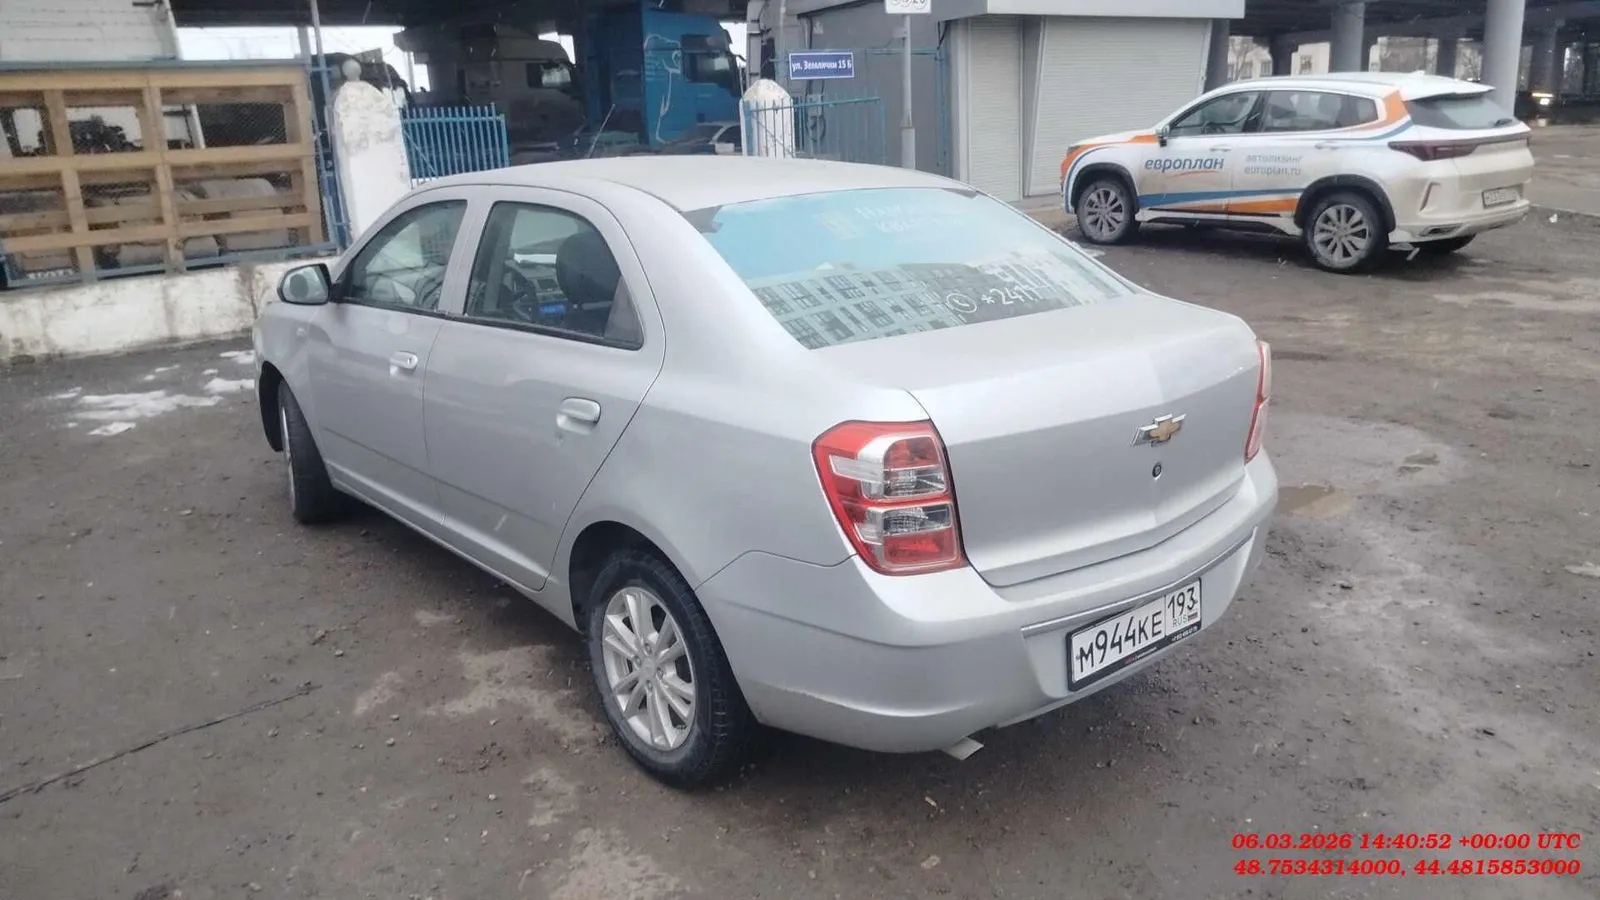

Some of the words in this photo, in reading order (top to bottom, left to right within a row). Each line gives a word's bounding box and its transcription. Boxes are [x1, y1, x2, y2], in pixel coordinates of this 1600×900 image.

[792, 62, 802, 72] ул.
[838, 60, 846, 69] 15
[1144, 156, 1224, 173] европлан
[1245, 154, 1303, 164] автолизинг
[1244, 165, 1301, 176] europlan.ru
[1172, 614, 1188, 627] RUS
[1077, 611, 1162, 673] М944КЕ
[1168, 587, 1197, 618] 193
